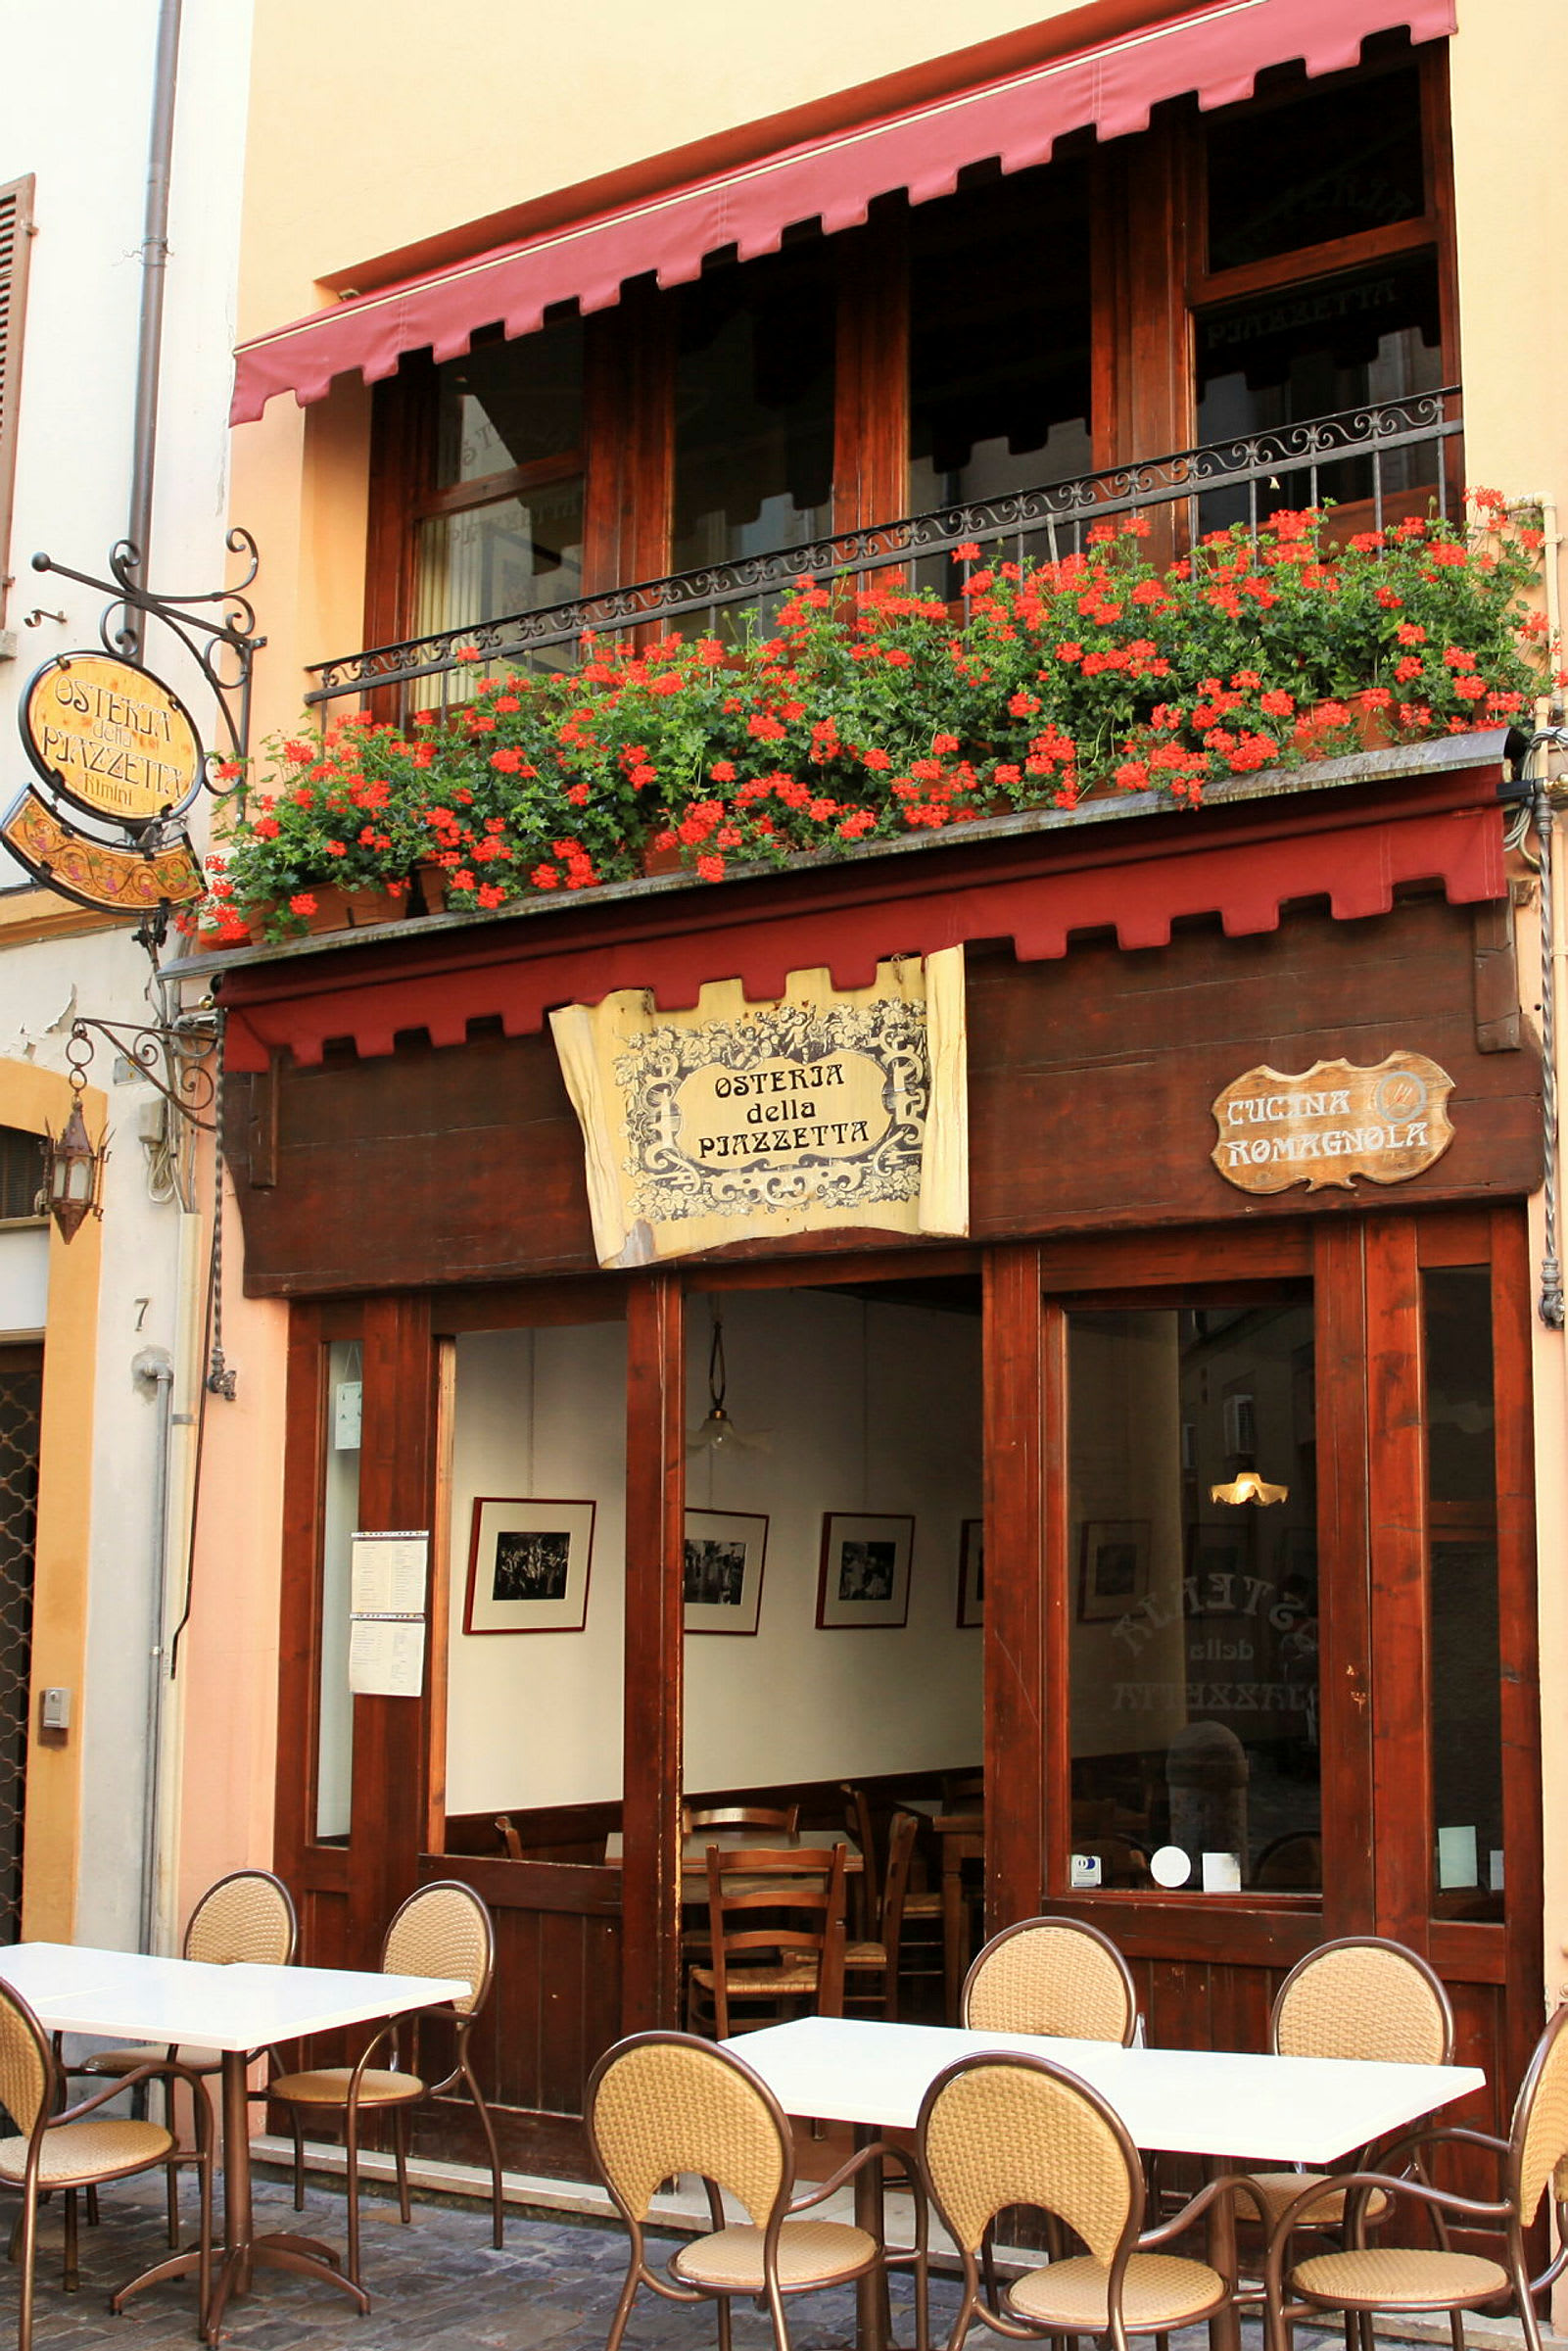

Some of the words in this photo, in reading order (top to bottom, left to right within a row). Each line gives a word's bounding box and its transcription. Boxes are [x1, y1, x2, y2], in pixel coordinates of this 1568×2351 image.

[56, 677, 170, 742] OSTERIA
[91, 719, 132, 747] della
[43, 727, 182, 799] PIAZZETTA
[715, 1063, 844, 1099] OSTERIA
[746, 1098, 817, 1125] della
[1227, 1089, 1352, 1127] CUCINA
[698, 1121, 869, 1158] PIAZZETTA
[1225, 1122, 1429, 1167] ROMAGNOLA
[134, 1297, 150, 1332] 7
